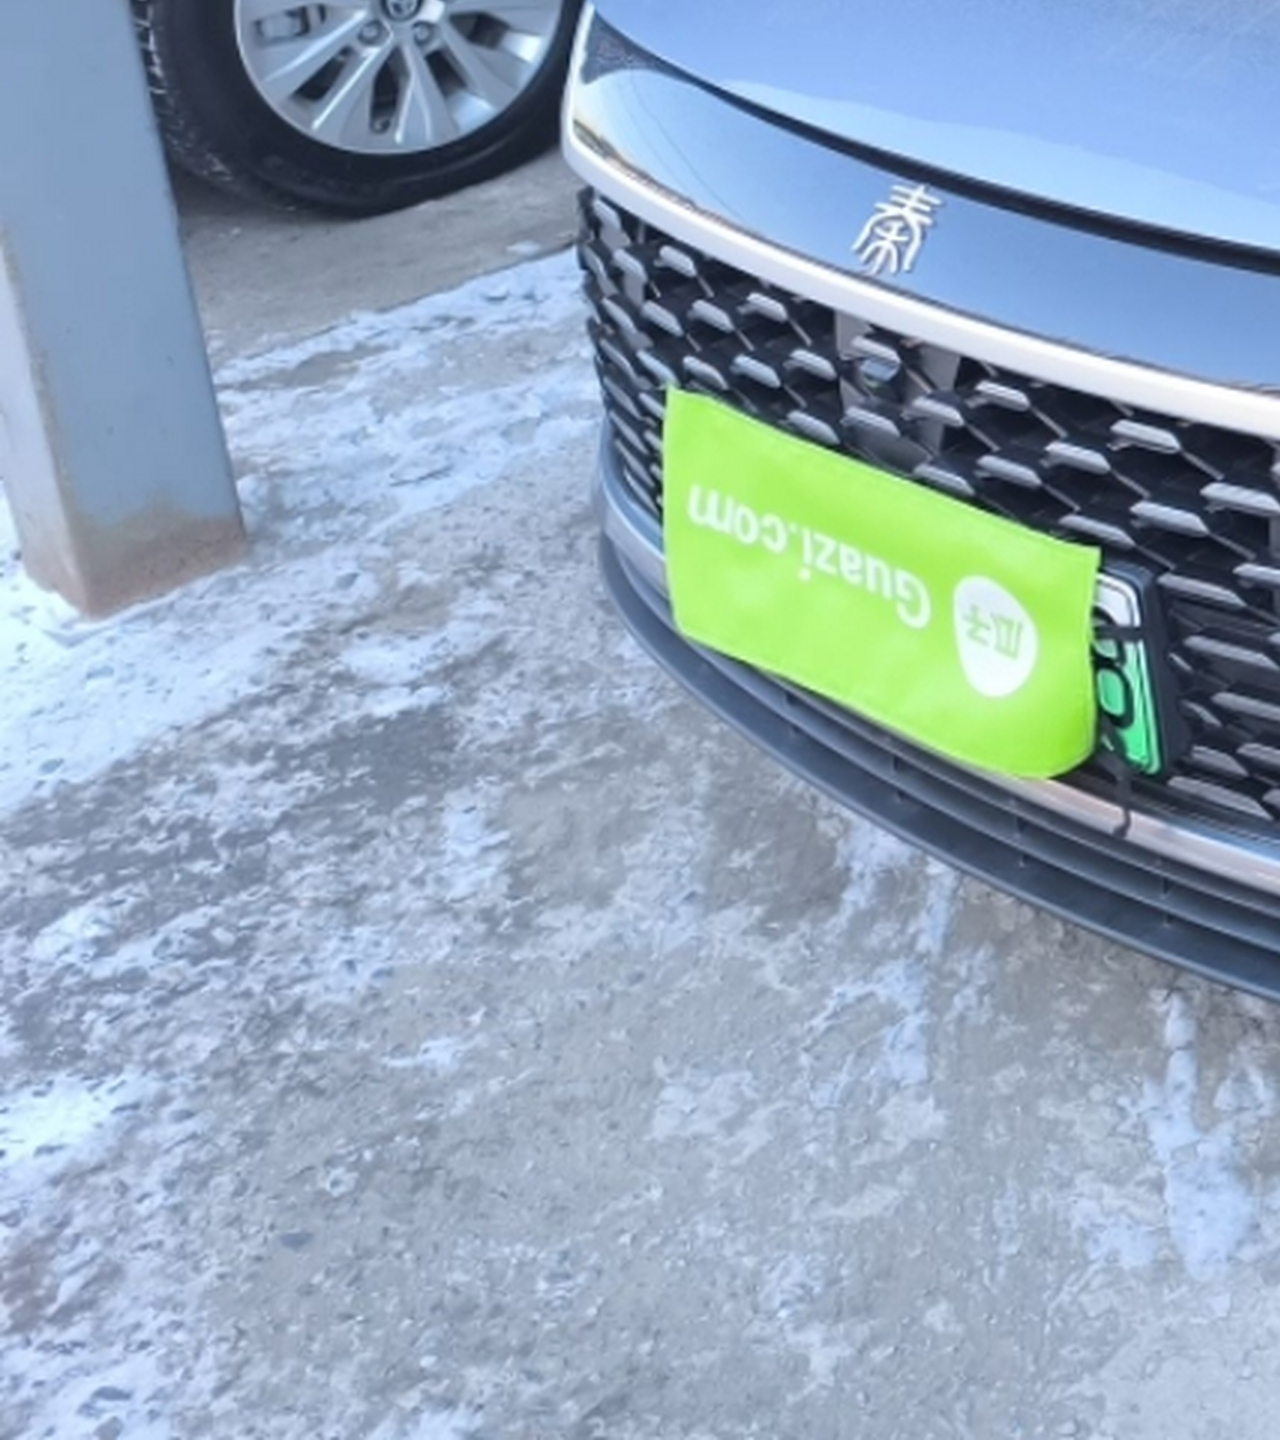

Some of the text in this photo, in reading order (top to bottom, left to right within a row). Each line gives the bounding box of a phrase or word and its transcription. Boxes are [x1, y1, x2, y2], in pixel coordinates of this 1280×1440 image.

[851, 183, 943, 276] 秦
[687, 483, 932, 630] Guazi.com
[963, 602, 1024, 661] 瓜子
